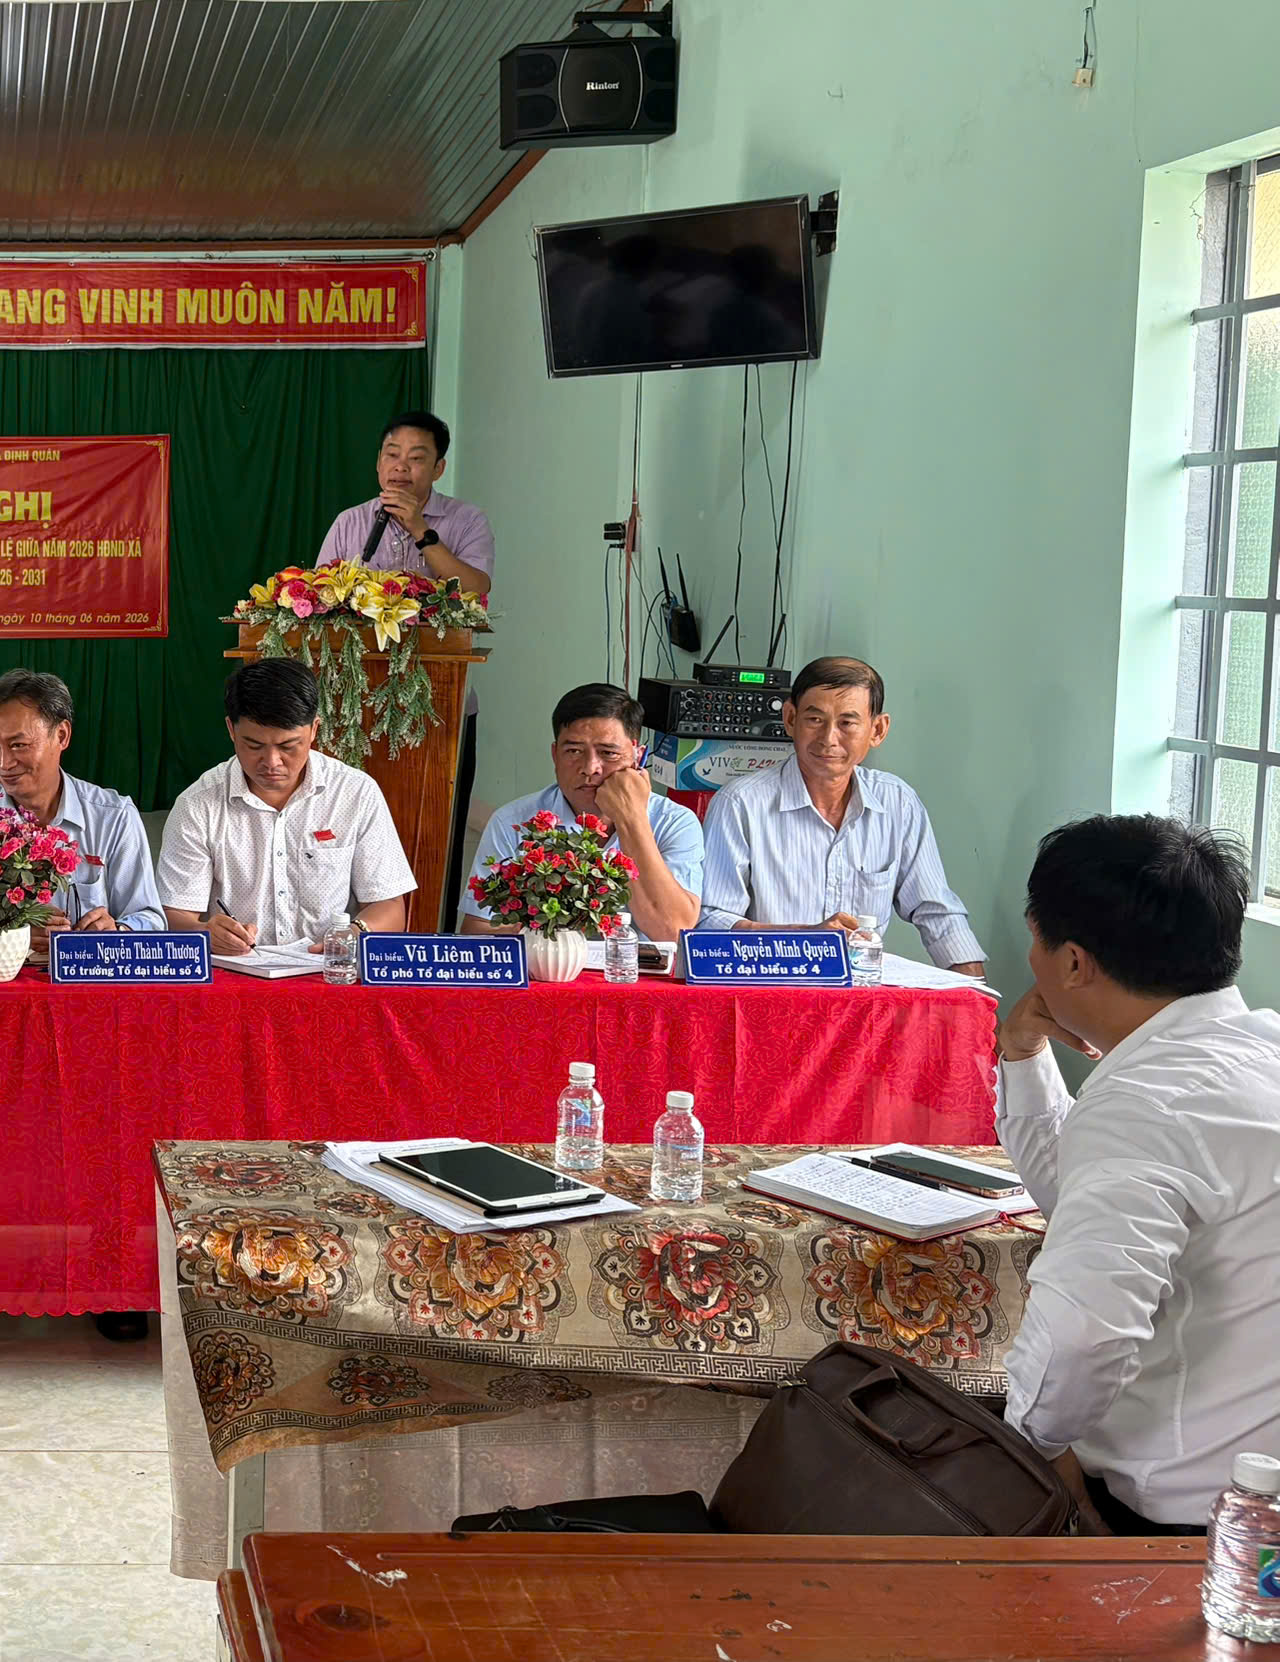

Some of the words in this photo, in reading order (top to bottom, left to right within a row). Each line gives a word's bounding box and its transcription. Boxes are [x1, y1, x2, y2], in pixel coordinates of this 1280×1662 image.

[586, 82, 619, 91] Rinton
[78, 288, 162, 324] VINH
[176, 282, 285, 324] MUÔN
[297, 281, 396, 323] NĂM!
[4, 450, 29, 463] ĐỊNH
[32, 449, 60, 462] QUÁN
[1, 537, 13, 561] LỆ
[16, 537, 40, 557] GIỮA
[42, 537, 66, 557] NĂM
[69, 540, 94, 557] 2026
[96, 540, 125, 557] HĐND
[22, 568, 46, 585] 2031
[30, 613, 41, 623] 10
[45, 612, 76, 625] tháng
[80, 613, 92, 623] 06
[96, 613, 120, 623] năm
[124, 612, 149, 623] 2026
[59, 951, 73, 962] Đại
[96, 939, 132, 963] Nguyễn
[133, 941, 164, 960] Thành
[369, 952, 383, 963] Đại
[404, 944, 428, 962] Vũ
[432, 944, 475, 963] Liêm
[478, 945, 513, 963] Phú
[692, 948, 707, 959] Đại
[732, 937, 772, 961] Nguyễn
[773, 940, 802, 958] Minh
[803, 940, 838, 962] Quyên
[62, 964, 76, 976] Tổ
[79, 965, 114, 977] trưởng
[117, 964, 132, 976] Tổ
[134, 965, 150, 978] đại
[154, 964, 176, 975] biểu
[179, 964, 193, 976] số
[194, 965, 202, 975] 4
[372, 966, 389, 978] Tổ
[392, 967, 414, 979] phó
[417, 966, 433, 978] Tổ
[436, 968, 454, 980] đại
[458, 967, 483, 979] biểu
[487, 968, 502, 979] số
[504, 969, 513, 979] 4
[715, 962, 733, 974] Tổ
[737, 964, 756, 976] đại
[760, 962, 789, 974] biểu
[792, 963, 808, 974] số
[811, 964, 821, 974] 4
